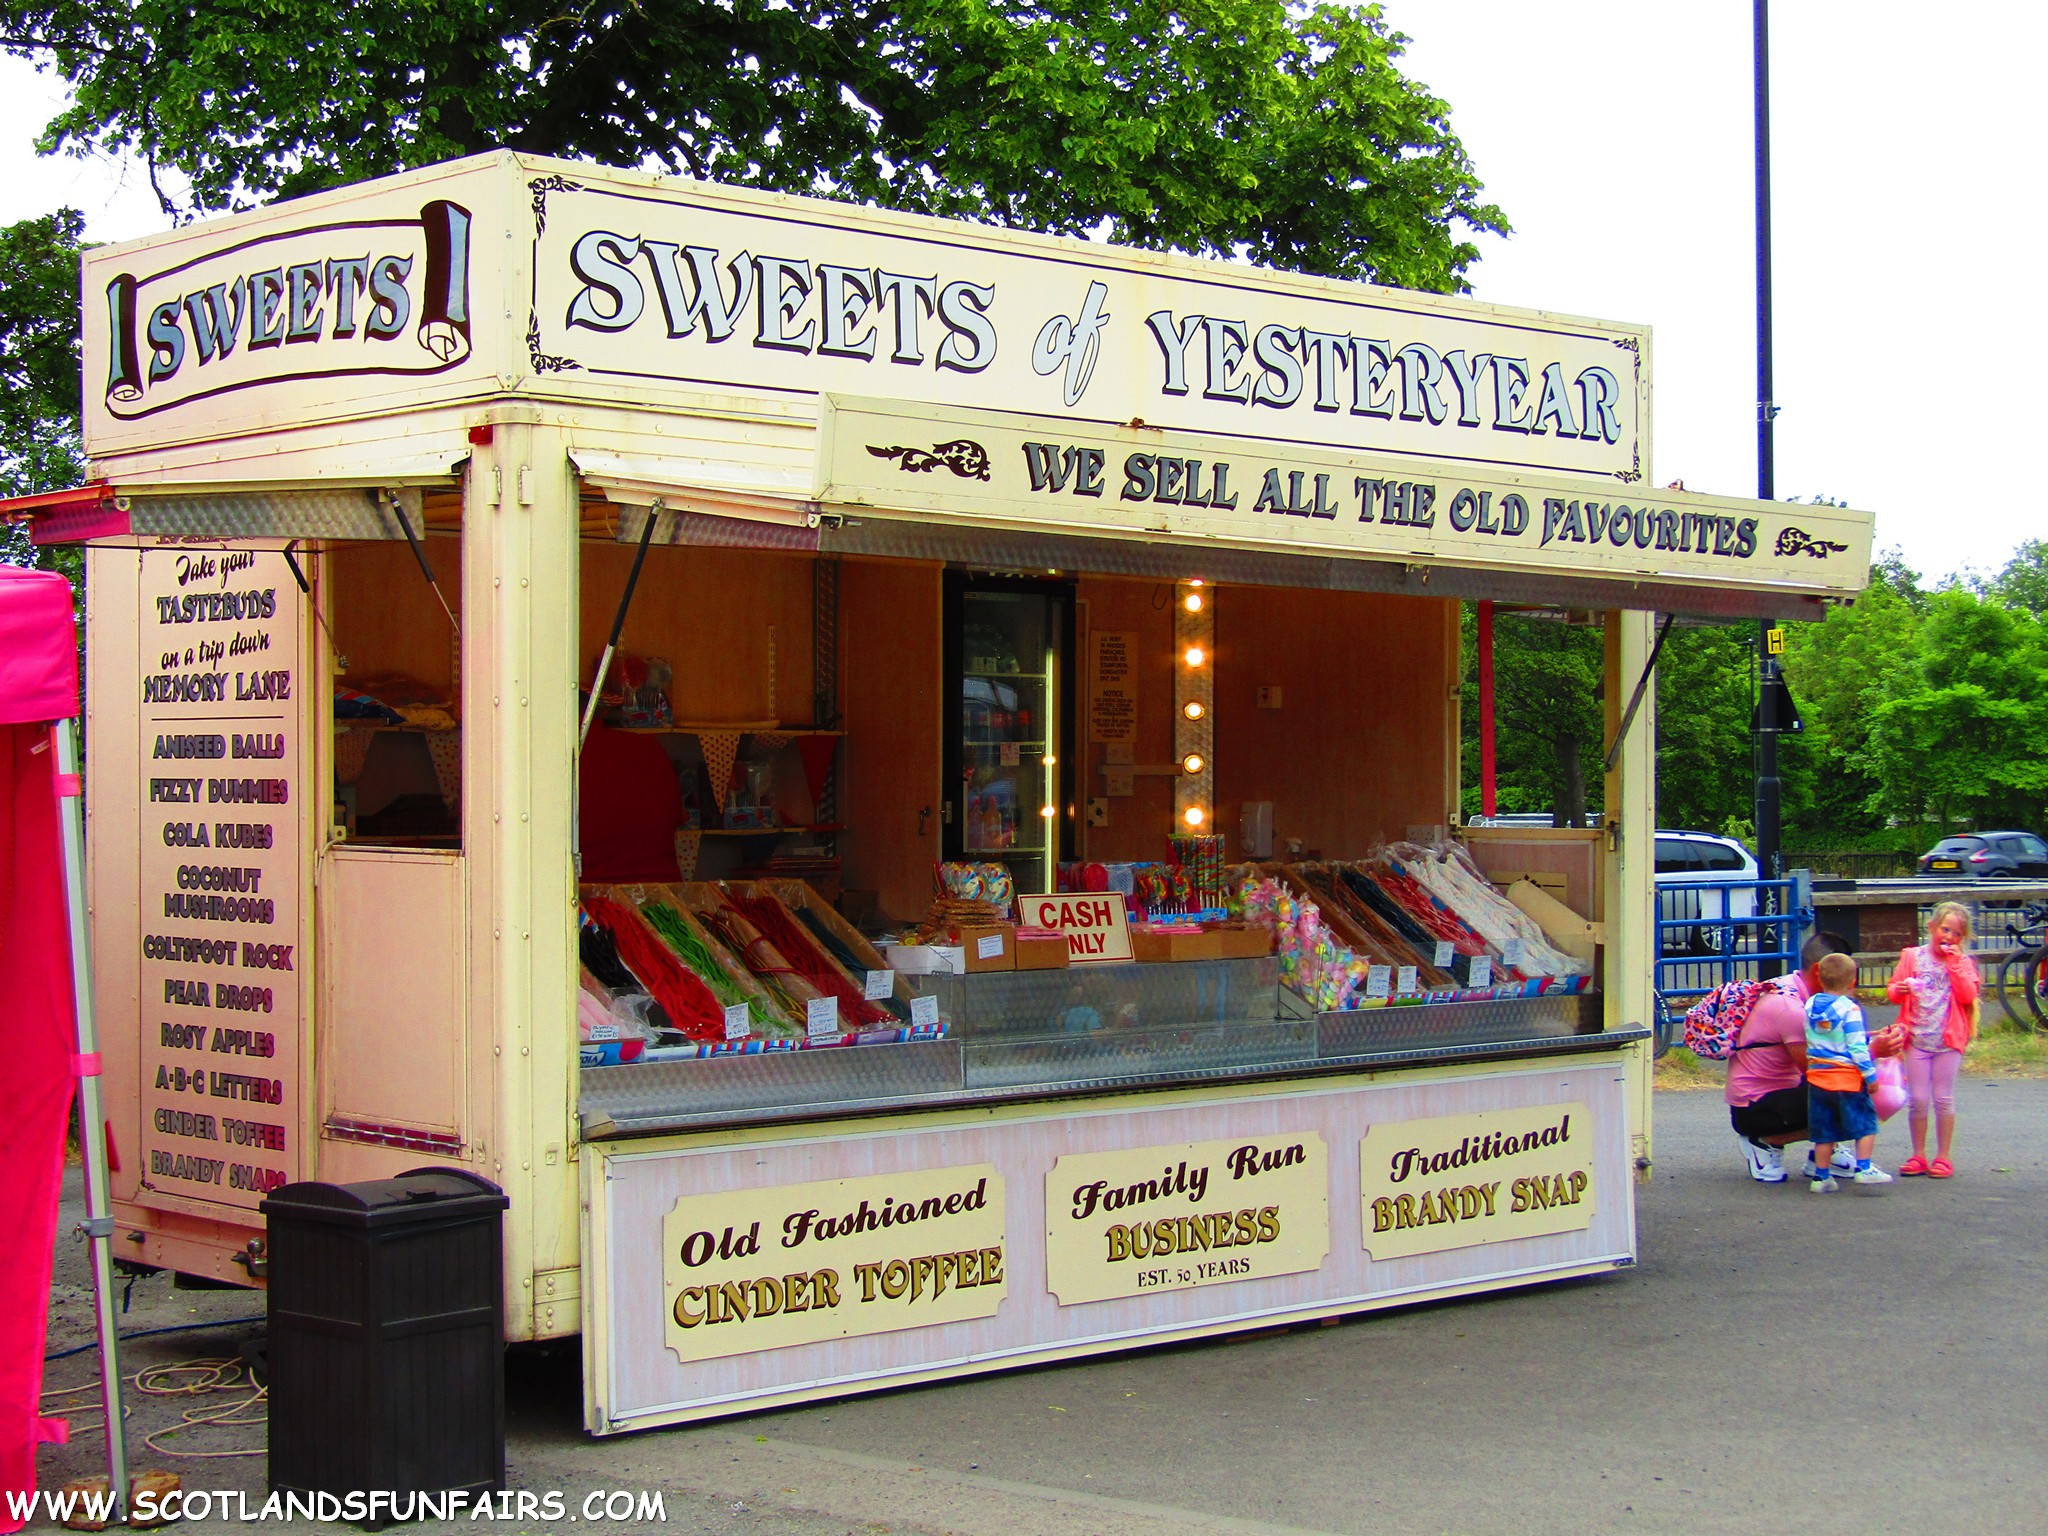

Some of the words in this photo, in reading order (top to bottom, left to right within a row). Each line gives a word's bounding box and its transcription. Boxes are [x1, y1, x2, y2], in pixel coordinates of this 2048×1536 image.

[148, 252, 414, 388] SWEETS
[566, 230, 998, 374] SWEETS
[1031, 280, 1110, 406] of
[1145, 310, 1622, 445] YESTERYEAR
[1022, 441, 1105, 497] WE
[1120, 447, 1239, 511] SELL
[1252, 467, 1338, 520] ALL
[1353, 474, 1436, 528] THE
[1449, 487, 1529, 536] OLD
[1540, 497, 1759, 560] FAVOURITES
[176, 554, 216, 587] Take
[220, 550, 255, 588] your
[157, 588, 276, 624] TASTEBUDS
[161, 651, 180, 671] on
[184, 648, 194, 666] a
[199, 640, 225, 671] trip
[229, 629, 271, 658] down
[1770, 631, 1782, 652] H
[143, 672, 230, 703] MEMORY
[235, 670, 291, 702] LANE
[153, 734, 226, 760] ANISEED
[232, 733, 285, 759] BALLS
[150, 777, 203, 804] FIZZY
[208, 778, 289, 805] DUMMIES
[163, 822, 210, 848] COLA
[215, 823, 273, 849] KUBES
[177, 865, 262, 894] COCONUT
[164, 894, 275, 924] MUSHROOMS
[1038, 900, 1113, 929] CASH
[143, 935, 237, 966] COLTSFOOT
[243, 942, 294, 972] ROCK
[1068, 932, 1106, 955] NLY
[164, 979, 211, 1007] PEAR
[216, 984, 273, 1013] DROPS
[161, 1023, 207, 1051] ROSY
[212, 1028, 275, 1058] APPLES
[210, 1071, 283, 1105] LETTERS
[154, 1108, 217, 1141] CINDER
[222, 1119, 286, 1151] TOFFEE
[1391, 1113, 1571, 1184] Traditional
[151, 1150, 224, 1185] BRANDY
[229, 1163, 287, 1193] SNAPS
[1071, 1160, 1210, 1221] Family
[1226, 1143, 1307, 1181] Run
[1371, 1182, 1502, 1234] BRANDY
[1510, 1170, 1589, 1214] SNAP
[680, 1221, 761, 1268] Old
[780, 1177, 988, 1249] Fashioned
[1105, 1204, 1281, 1263] BUSINESS
[673, 1267, 841, 1329] CINDER
[854, 1245, 1004, 1306] TOFFEE
[1137, 1267, 1173, 1289] EST.
[1196, 1257, 1251, 1280] YEARS
